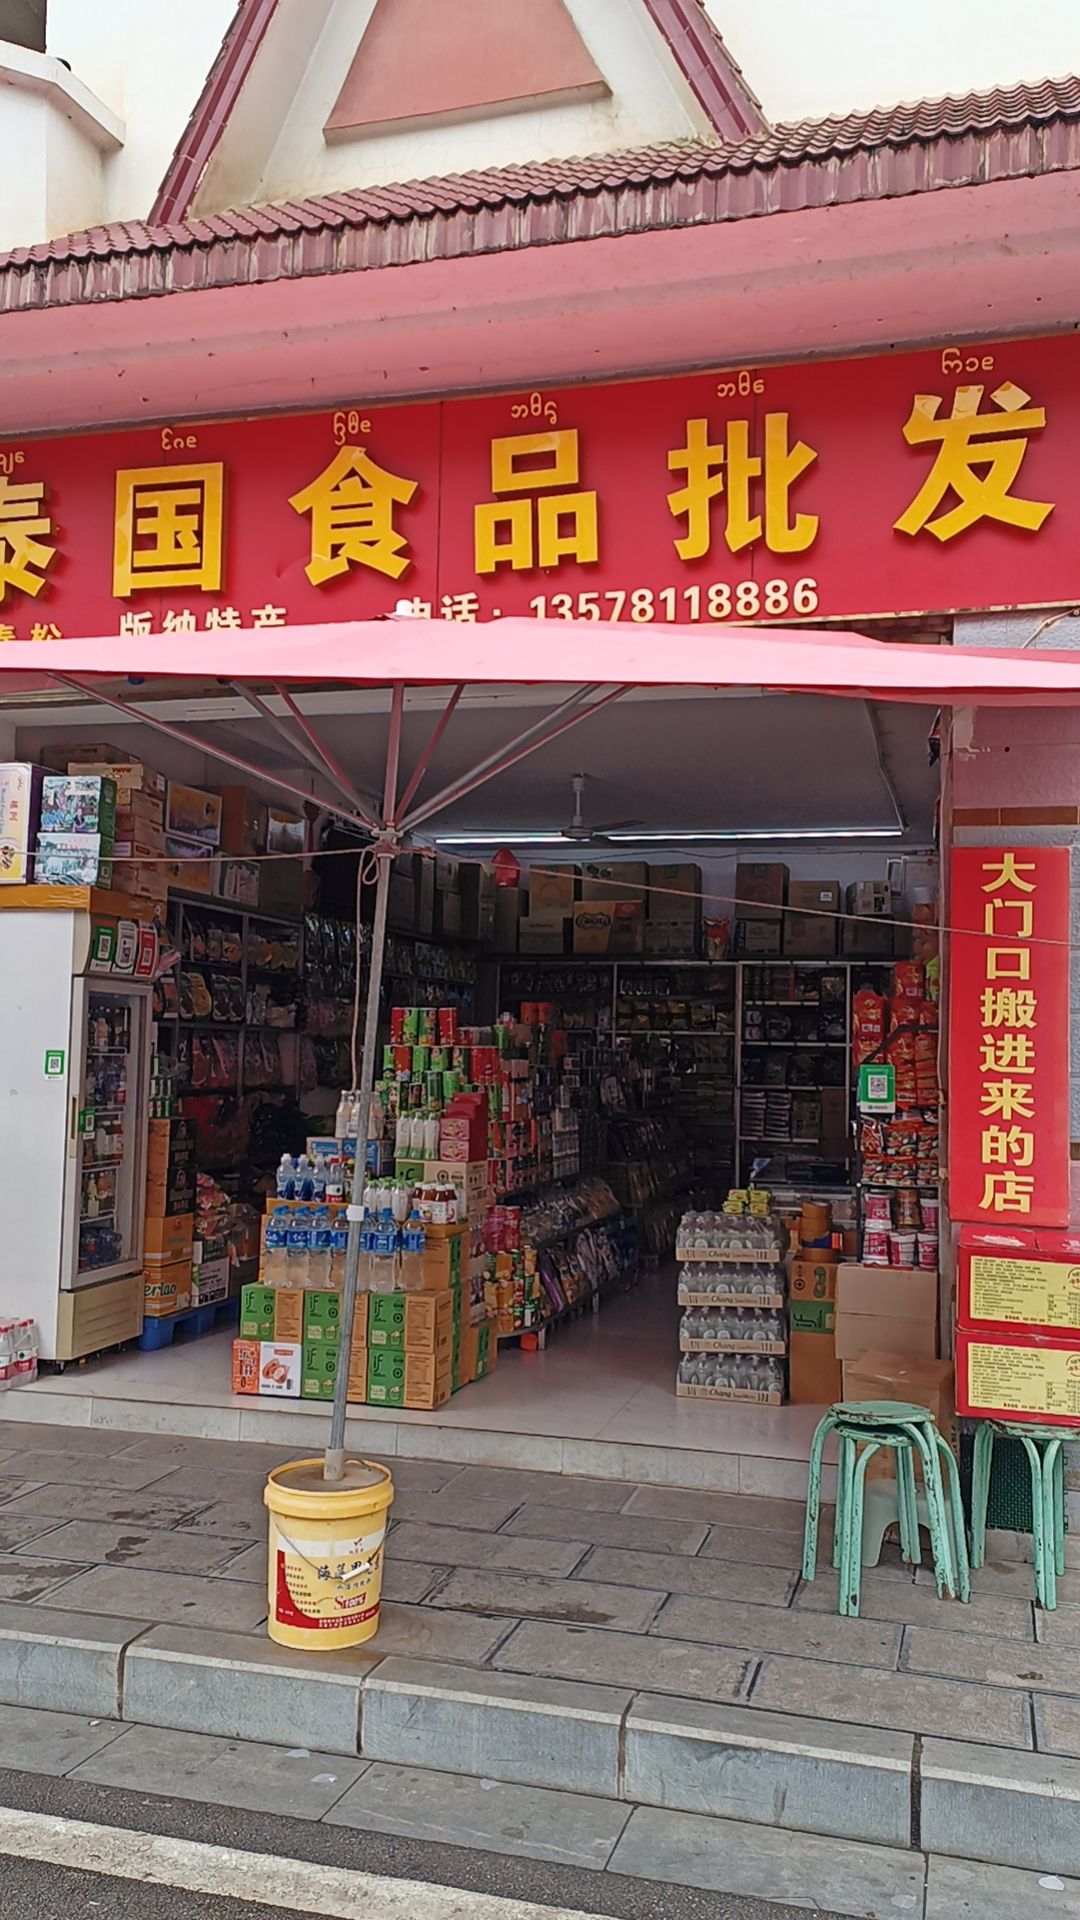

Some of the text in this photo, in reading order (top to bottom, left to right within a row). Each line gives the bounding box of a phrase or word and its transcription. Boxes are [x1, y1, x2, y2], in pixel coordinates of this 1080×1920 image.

[119, 604, 287, 637] 版纳特产
[529, 577, 820, 622] 13578118886
[979, 852, 1037, 1214] 大门口搬进来的店
